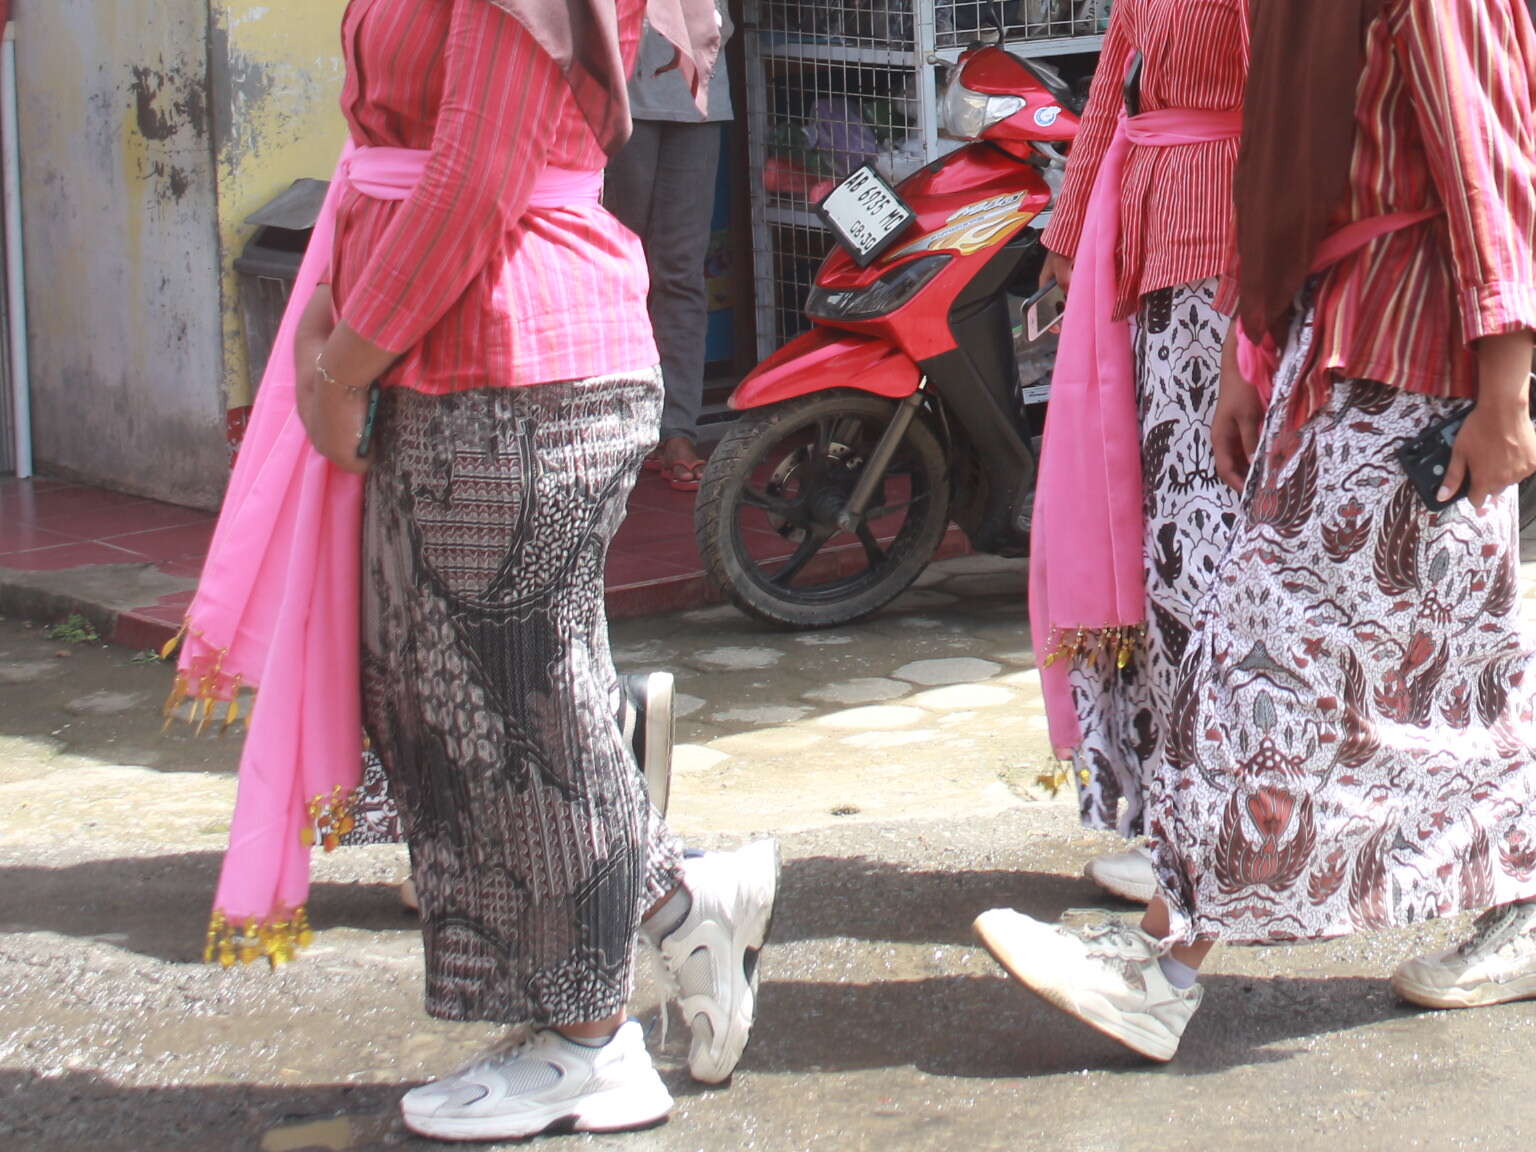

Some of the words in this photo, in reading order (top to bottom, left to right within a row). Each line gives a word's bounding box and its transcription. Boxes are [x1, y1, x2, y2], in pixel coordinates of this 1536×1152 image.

[844, 171, 869, 193] AB
[857, 186, 891, 216] 6935
[879, 208, 905, 232] MC
